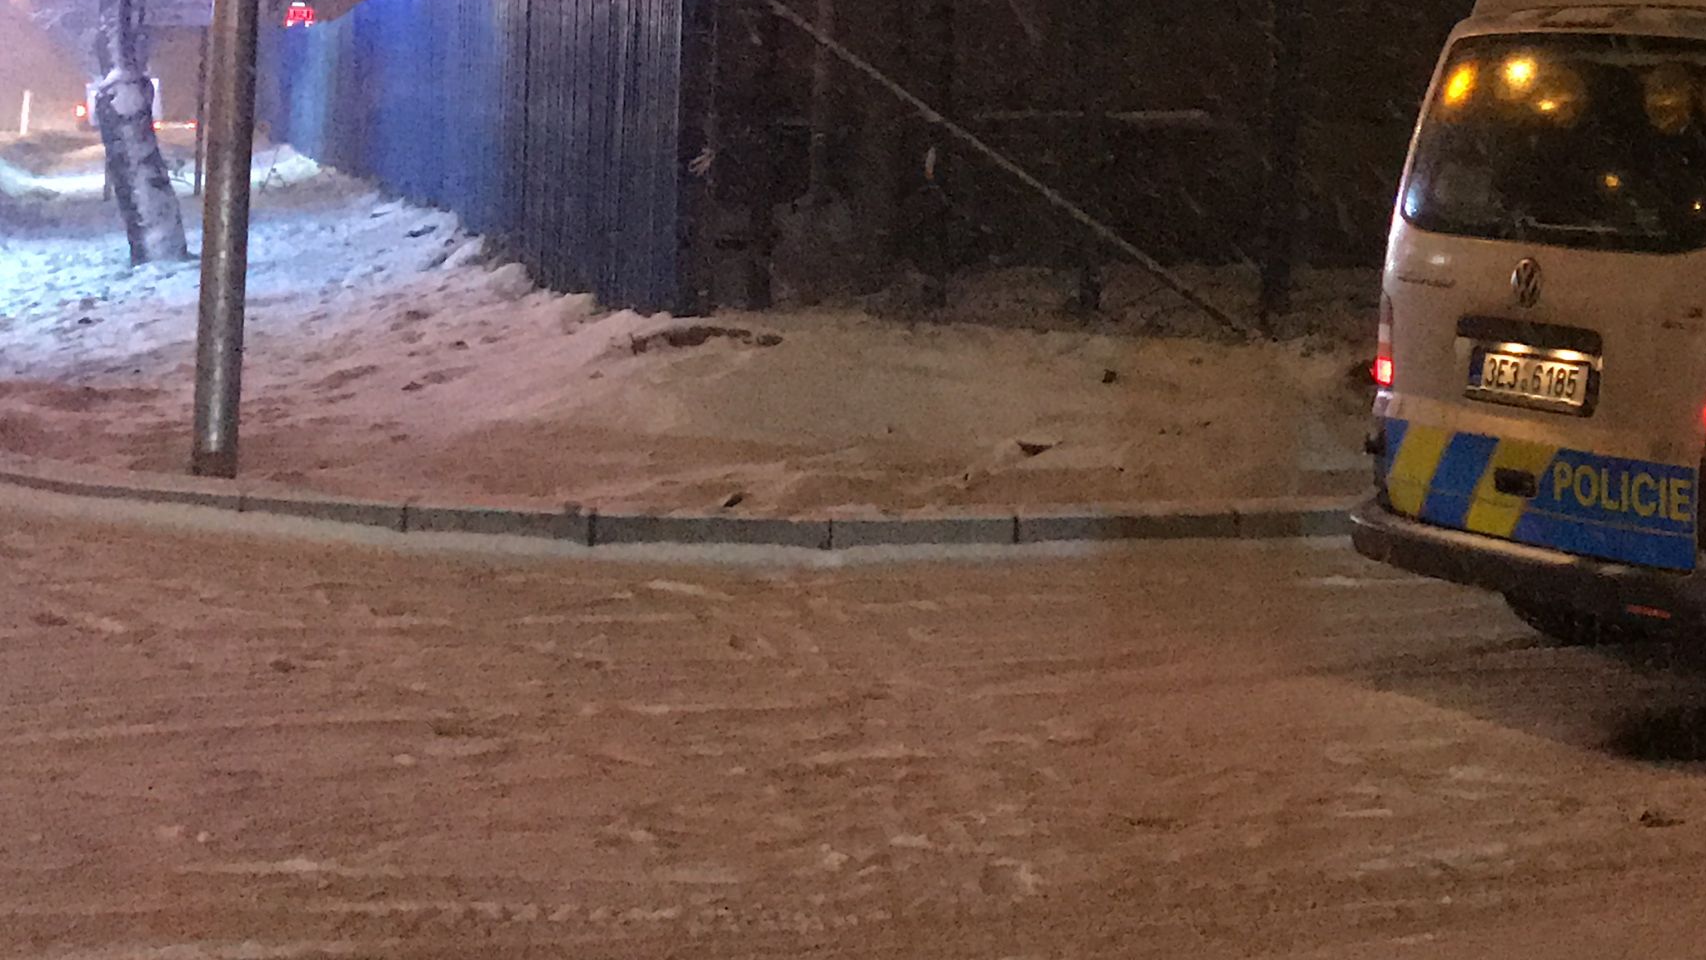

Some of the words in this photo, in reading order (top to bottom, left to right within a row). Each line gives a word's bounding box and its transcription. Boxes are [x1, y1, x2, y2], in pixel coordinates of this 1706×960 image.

[1485, 357, 1520, 389] 3E3
[1531, 364, 1580, 398] 6185
[1552, 460, 1693, 522] POLICIE
